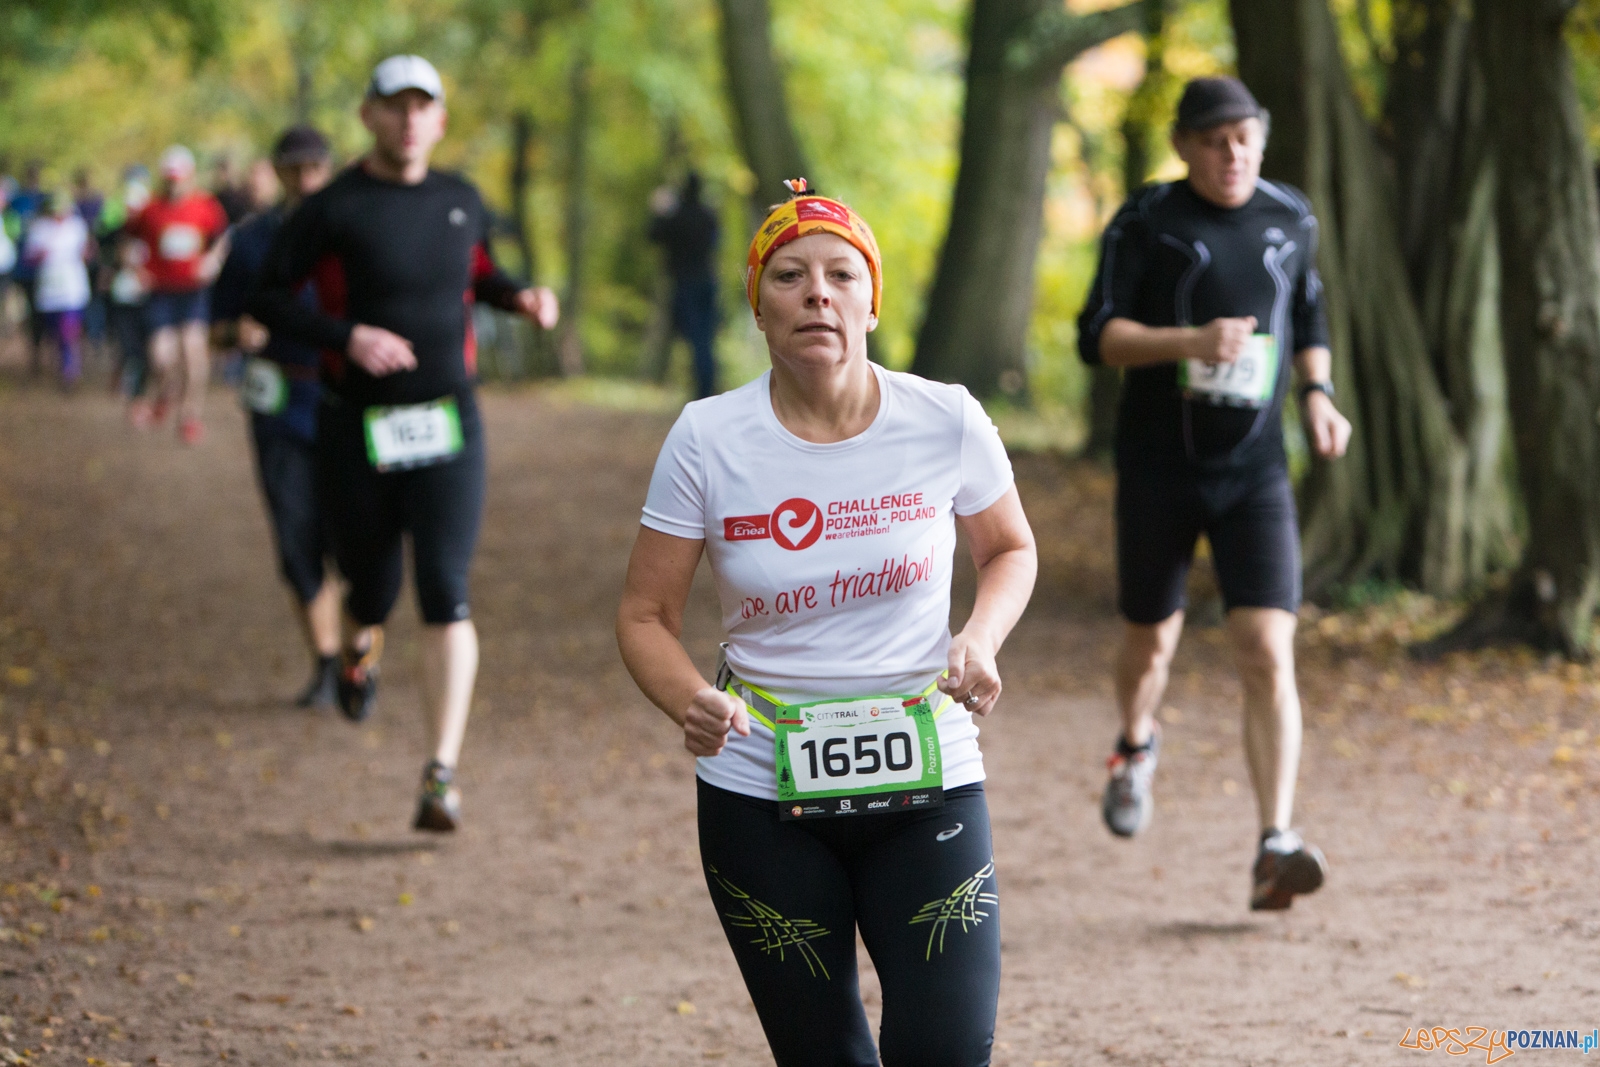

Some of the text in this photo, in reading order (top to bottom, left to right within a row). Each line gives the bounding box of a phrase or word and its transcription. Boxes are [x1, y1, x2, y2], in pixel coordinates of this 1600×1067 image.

[825, 510, 879, 531] POZNAŃ
[890, 506, 937, 524] POLAND
[827, 492, 924, 516] CHALLENGE
[733, 526, 766, 537] Enea
[741, 545, 935, 620] we are triathlon!
[800, 731, 914, 780] 1650
[925, 736, 937, 774] Poznań
